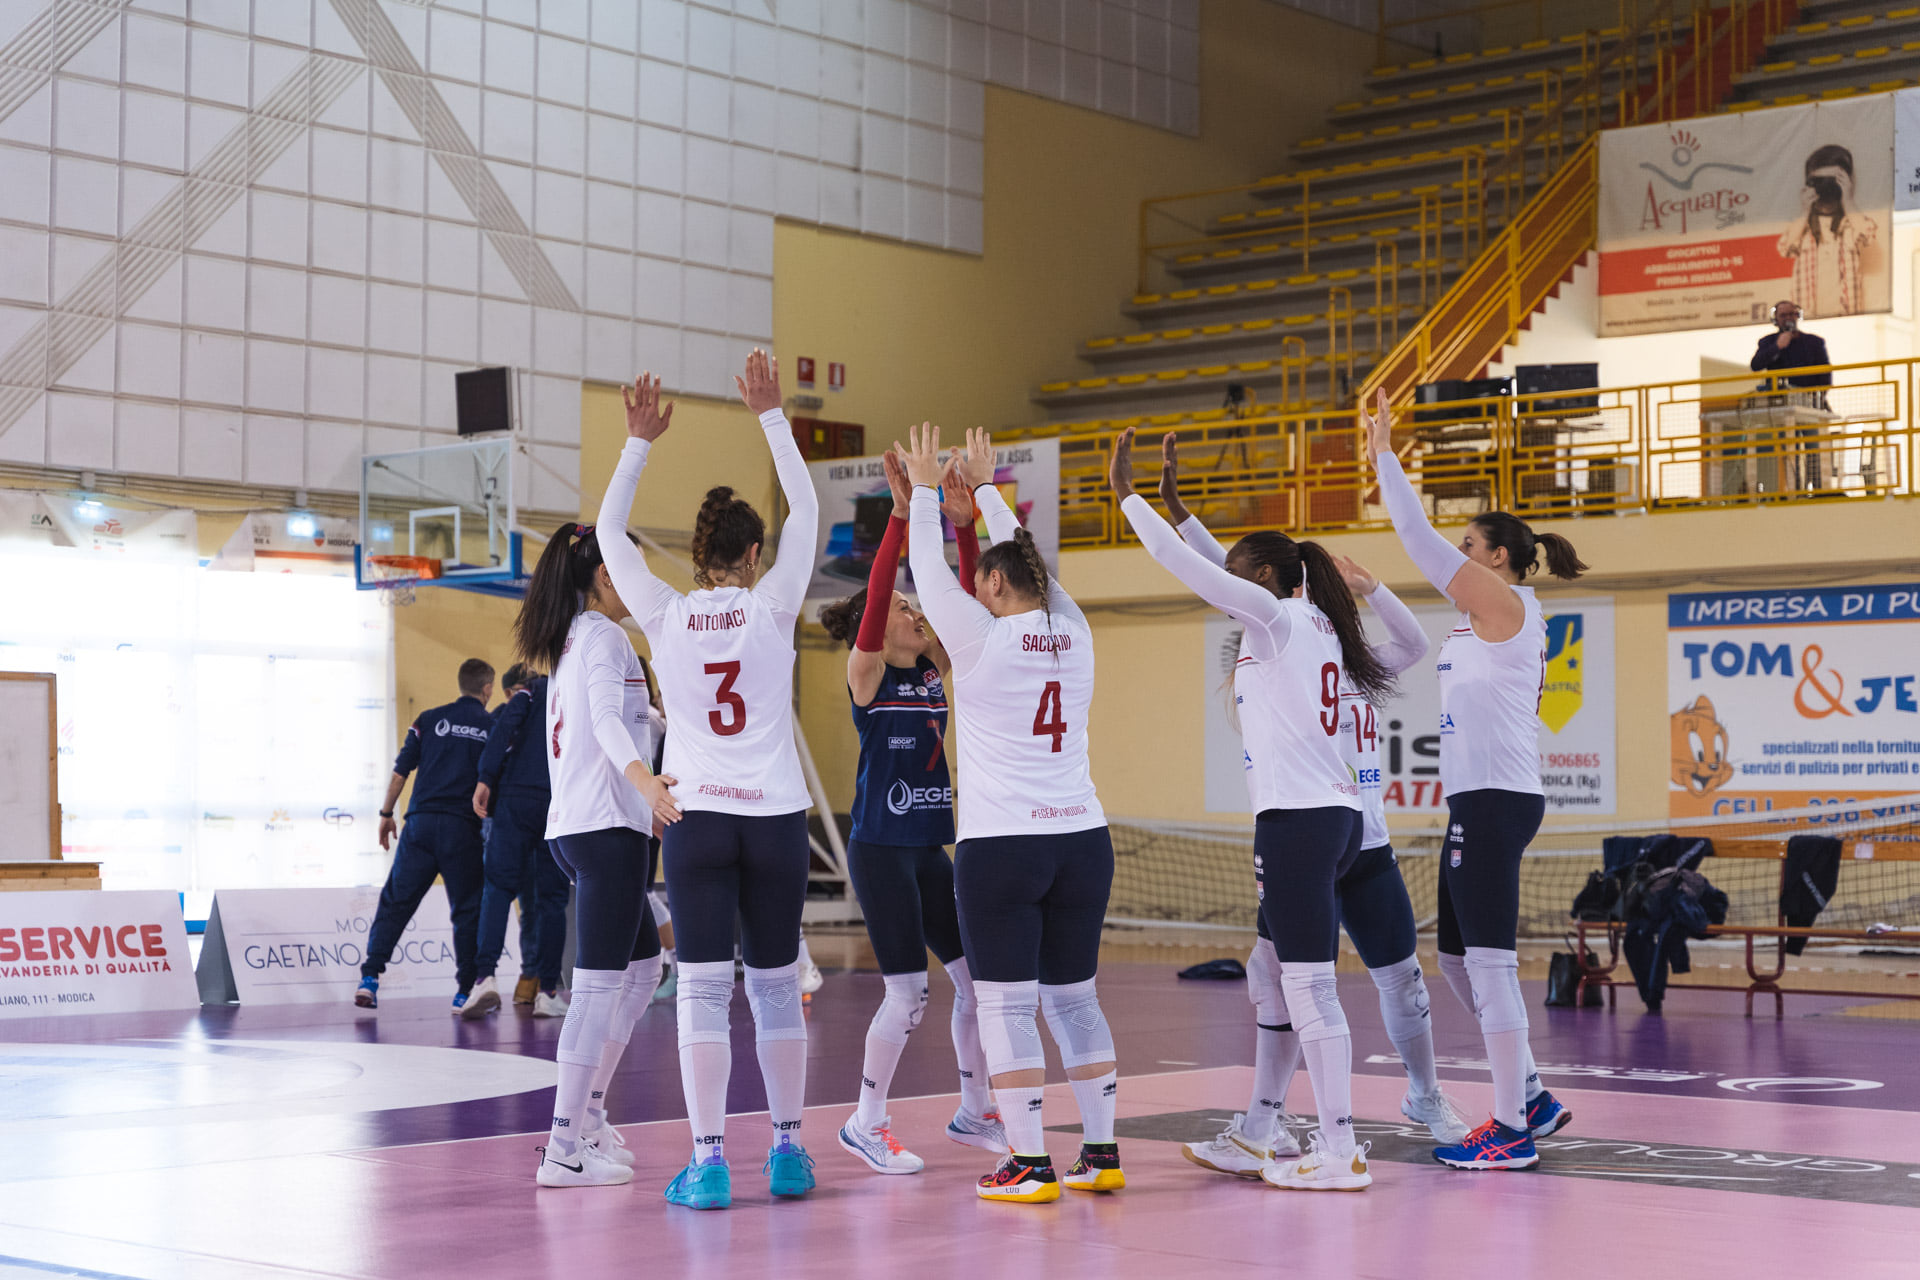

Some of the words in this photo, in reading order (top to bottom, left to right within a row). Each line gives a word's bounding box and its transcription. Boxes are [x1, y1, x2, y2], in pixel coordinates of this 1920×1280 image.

[1639, 181, 1750, 235] Acquario
[829, 464, 855, 480] VIENI
[857, 465, 864, 478] A
[1007, 448, 1033, 463] ASUS
[687, 608, 747, 632] ANTONACI
[1687, 595, 1829, 622] IMPRESA
[1841, 593, 1875, 616] DI
[1683, 641, 1794, 680] TOM
[1793, 643, 1855, 720] &
[1854, 675, 1919, 714] JE
[704, 660, 746, 737] 3
[1320, 662, 1339, 736] 9
[1033, 681, 1067, 752] 4
[1351, 704, 1376, 752] 14
[452, 725, 488, 739] EGEA
[927, 719, 944, 771] 7
[1763, 740, 1839, 756] specializzati
[1842, 740, 1873, 755] nella
[1548, 753, 1600, 768] 906865
[1742, 760, 1782, 776] servizi
[1784, 760, 1796, 775] di
[1798, 760, 1840, 777] pulizia
[1842, 762, 1864, 777] per
[1866, 760, 1909, 776] privati
[1911, 763, 1920, 774] e
[1359, 769, 1380, 783] EGE
[1541, 775, 1573, 786] ODICA
[913, 787, 952, 802] EGE
[1545, 793, 1600, 806] rtigianale
[0, 924, 167, 962] SERVICE
[244, 942, 362, 969] GAETANO
[85, 963, 100, 976] DI
[106, 957, 172, 975] QUALITÀ
[32, 994, 48, 1005] 111
[57, 992, 96, 1004] MODICA
